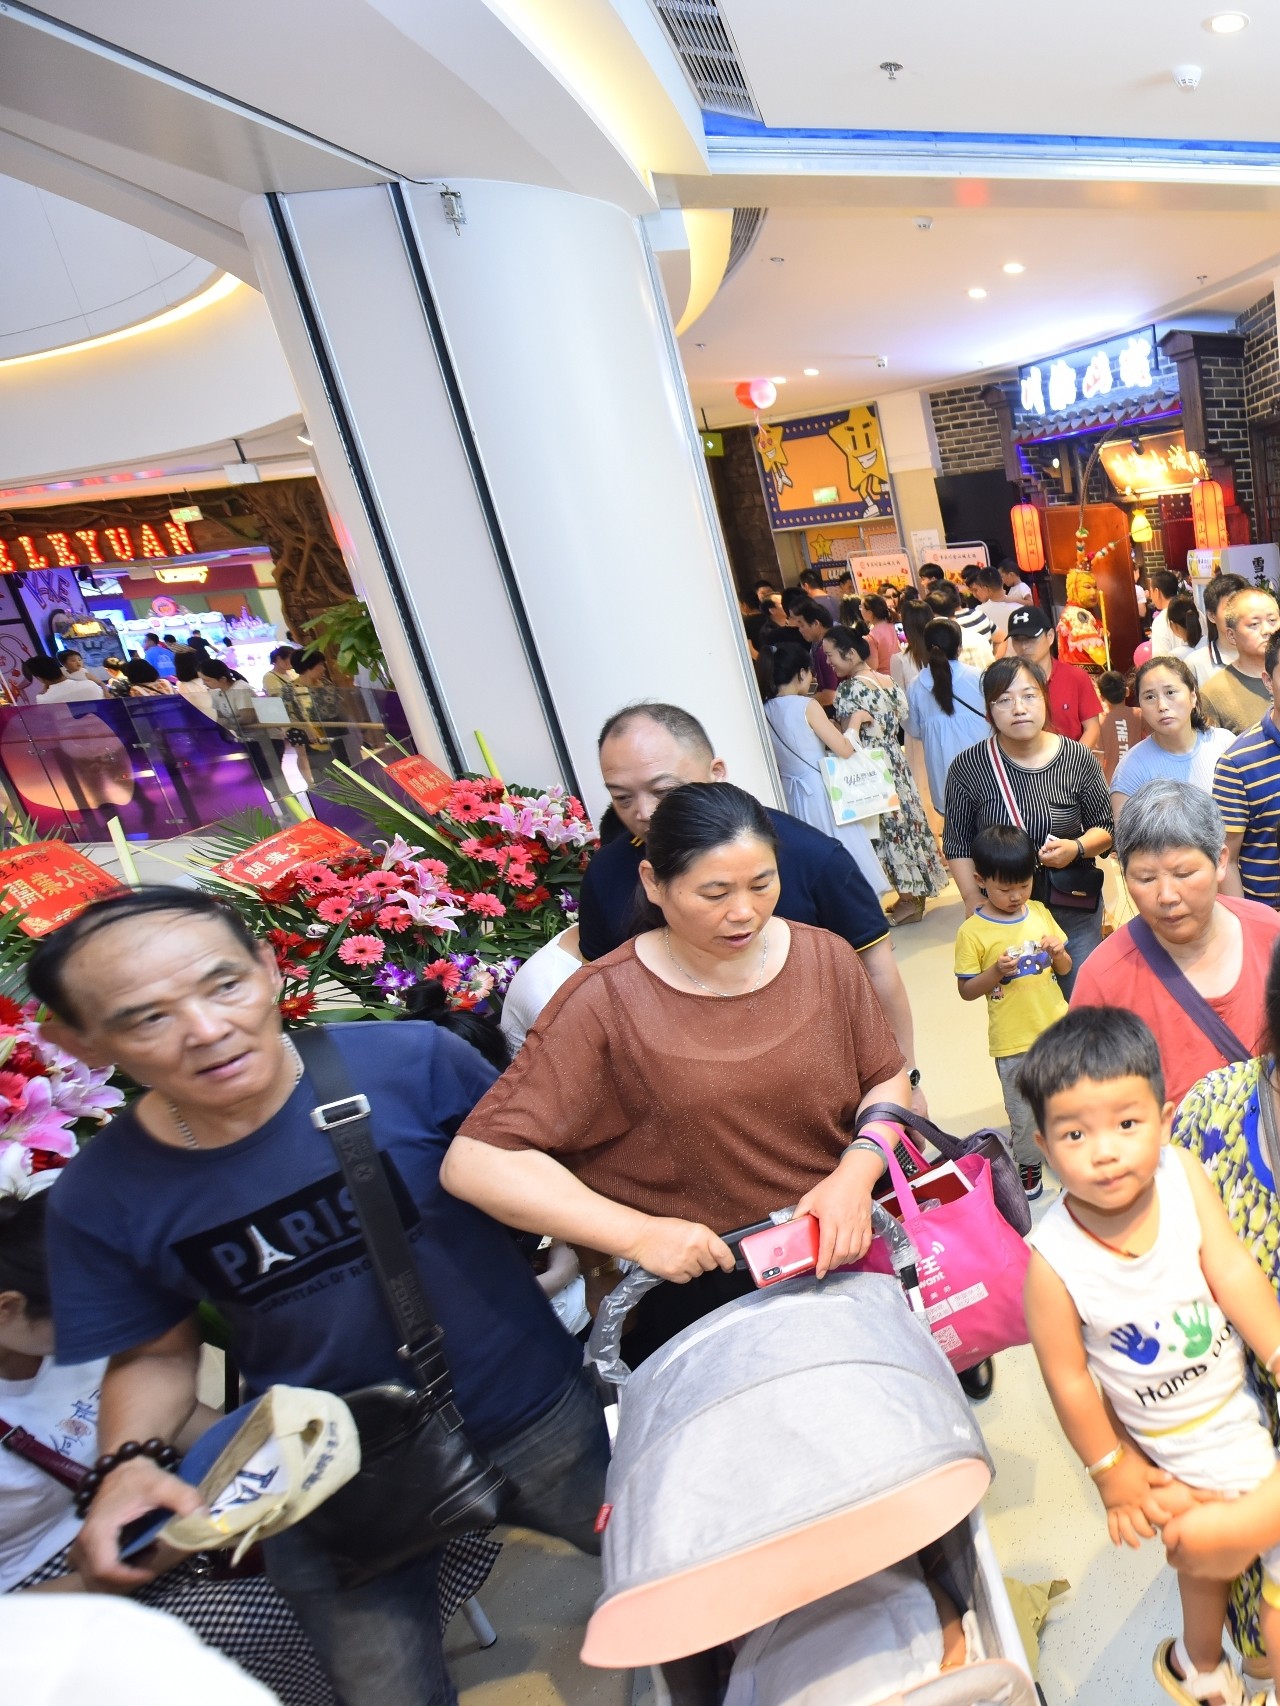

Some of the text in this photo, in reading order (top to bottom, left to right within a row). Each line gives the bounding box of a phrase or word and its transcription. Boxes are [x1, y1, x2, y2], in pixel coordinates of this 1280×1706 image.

[243, 833, 328, 880] 開業大吉
[2, 862, 100, 909] 開業大吉
